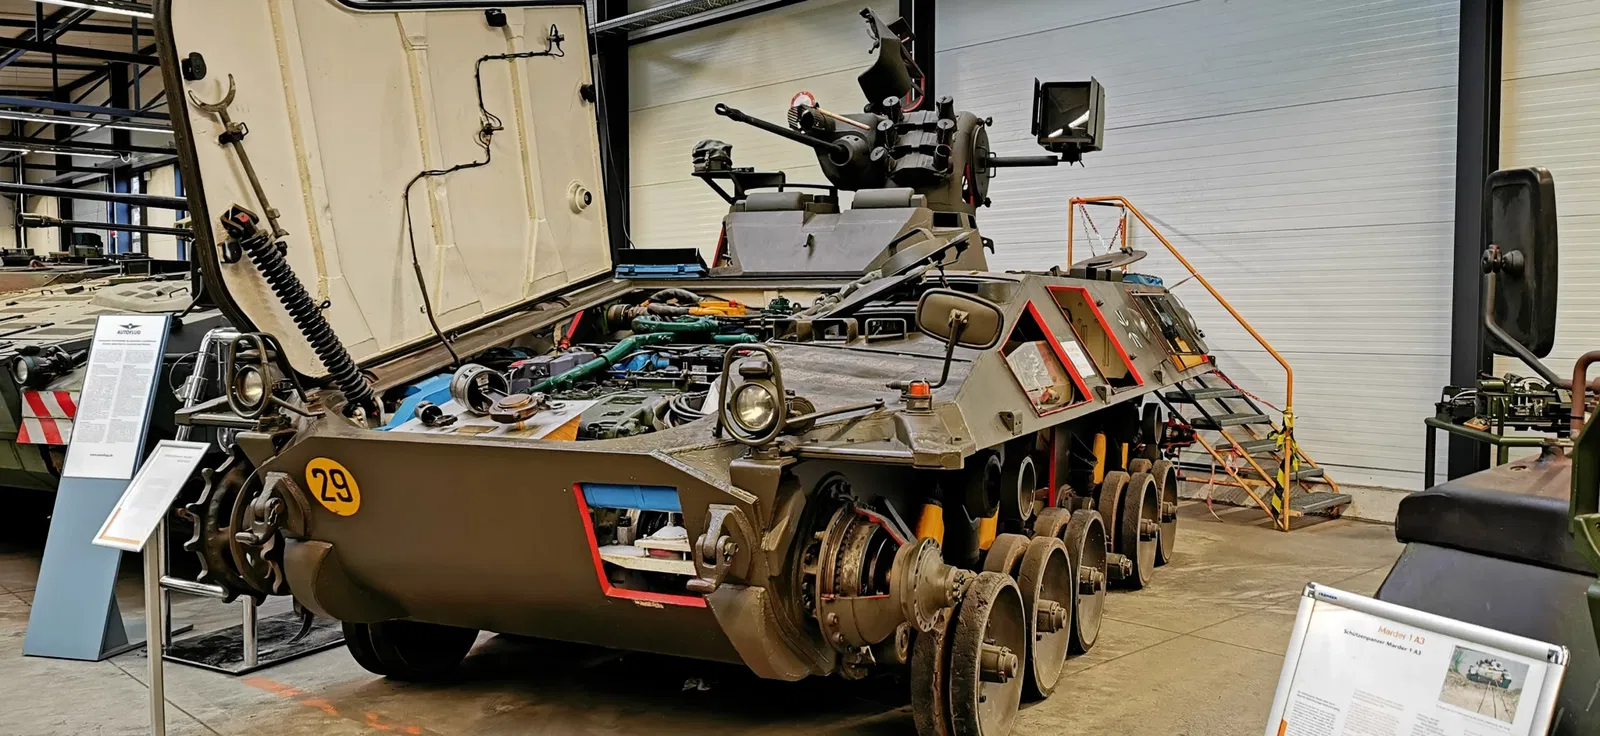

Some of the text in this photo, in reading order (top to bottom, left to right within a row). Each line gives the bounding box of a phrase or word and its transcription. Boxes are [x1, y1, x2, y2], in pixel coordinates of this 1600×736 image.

[311, 467, 354, 503] 29
[1344, 629, 1385, 644] Schützenpanzer
[1386, 641, 1407, 651] Marder
[1378, 626, 1406, 640] Marder
[1414, 635, 1425, 645] A3
